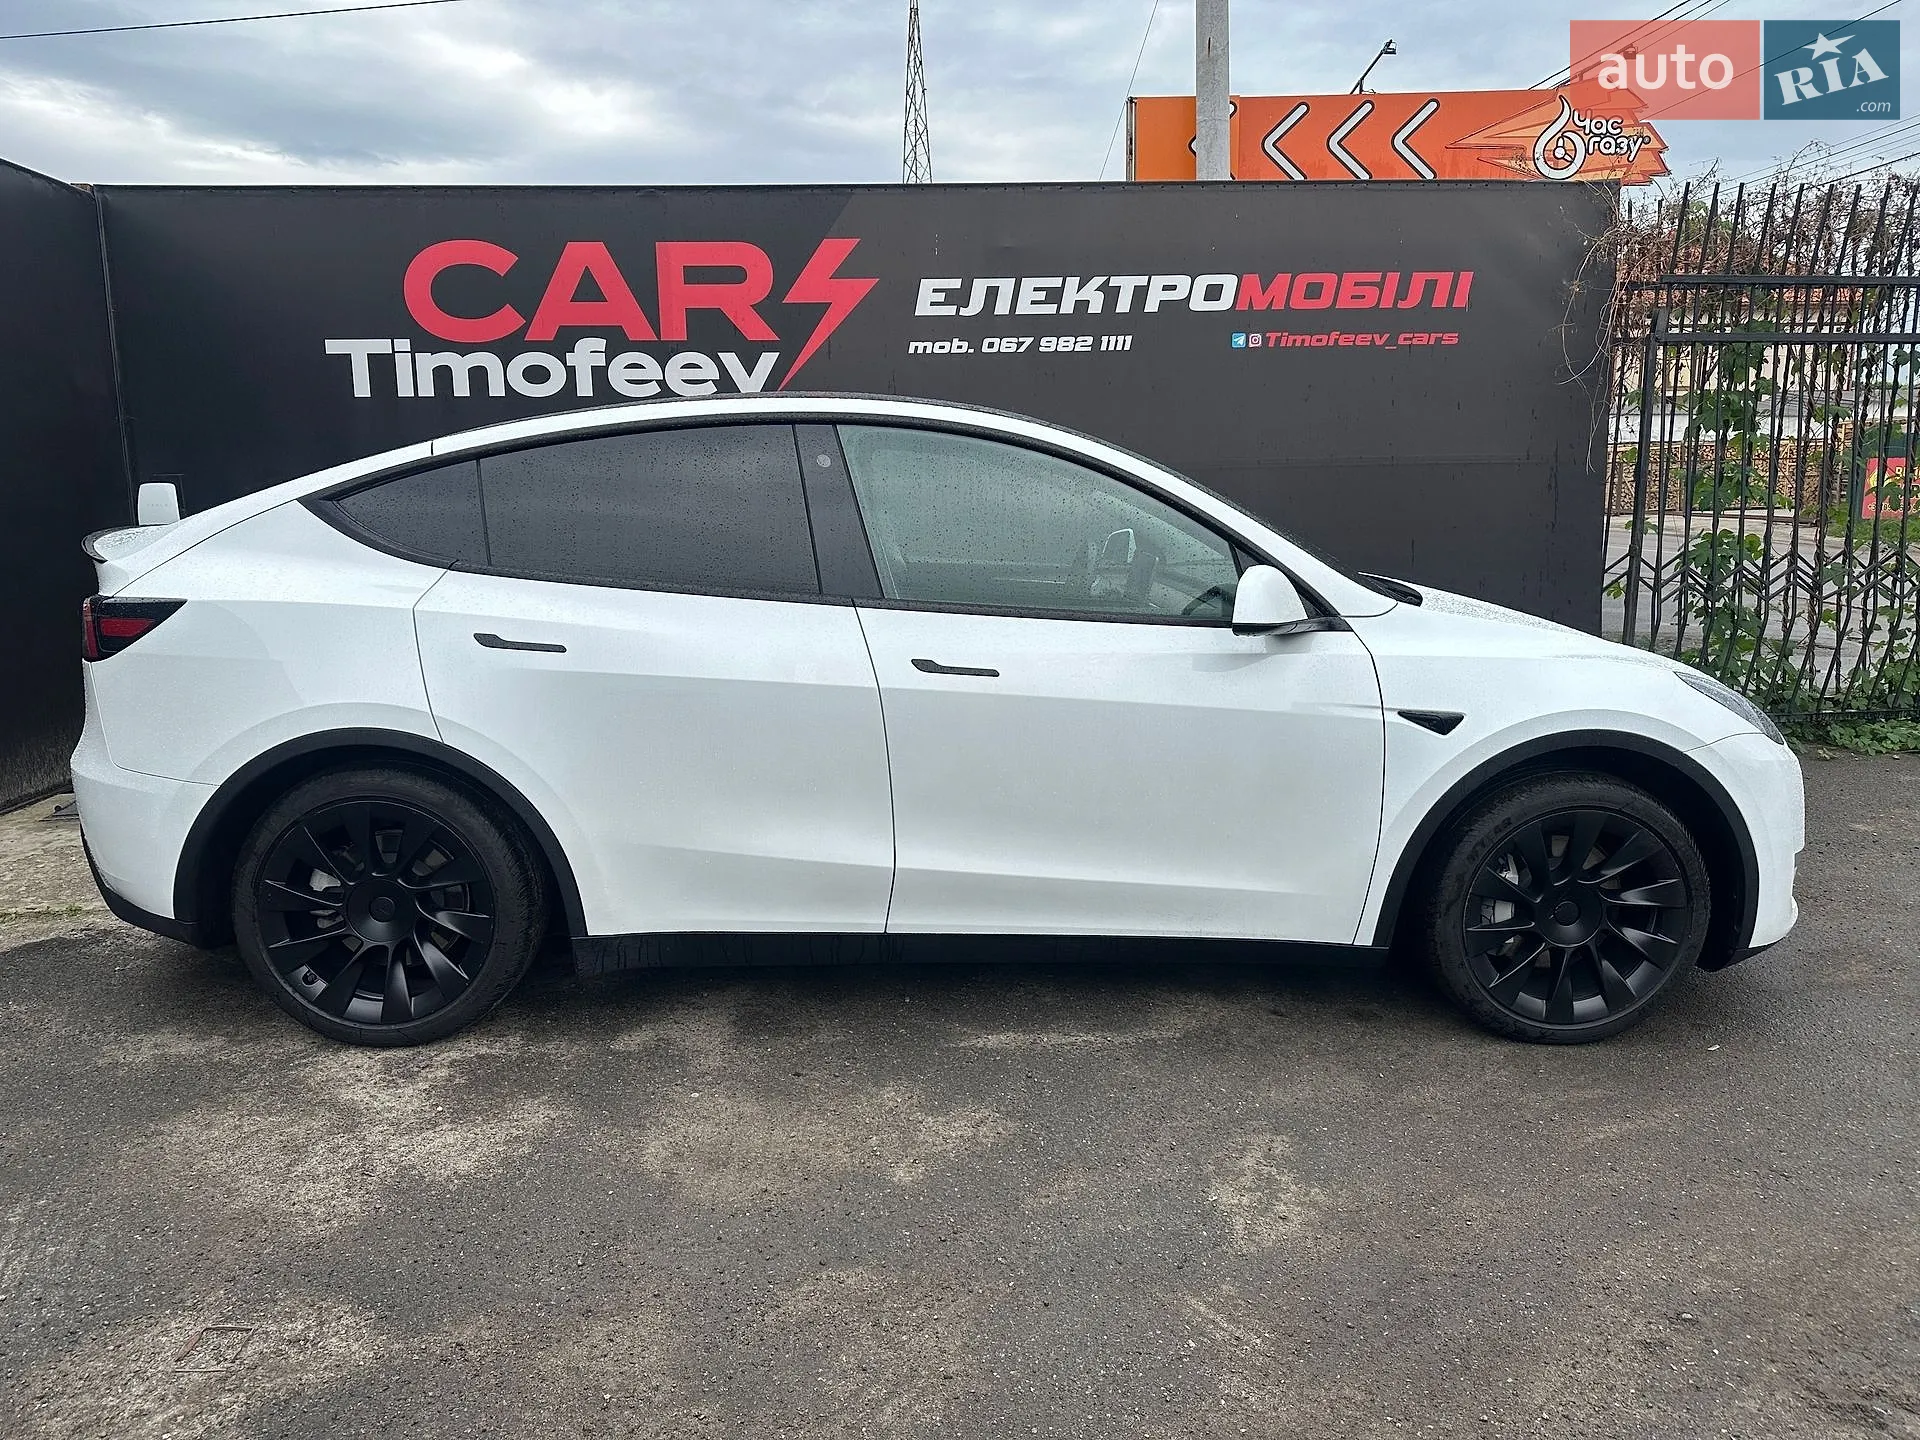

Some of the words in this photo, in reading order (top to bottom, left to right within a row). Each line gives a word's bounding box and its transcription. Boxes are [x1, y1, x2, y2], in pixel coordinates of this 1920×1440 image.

[914, 271, 1475, 316] ЕЛЕКТРОМОБІЛІ
[908, 337, 975, 354] mob.
[981, 336, 1034, 353] 067
[1038, 335, 1094, 352] 982
[1099, 335, 1133, 351] 1111
[1265, 331, 1460, 350] Timofeev_cars
[324, 336, 781, 398] Timofeev
